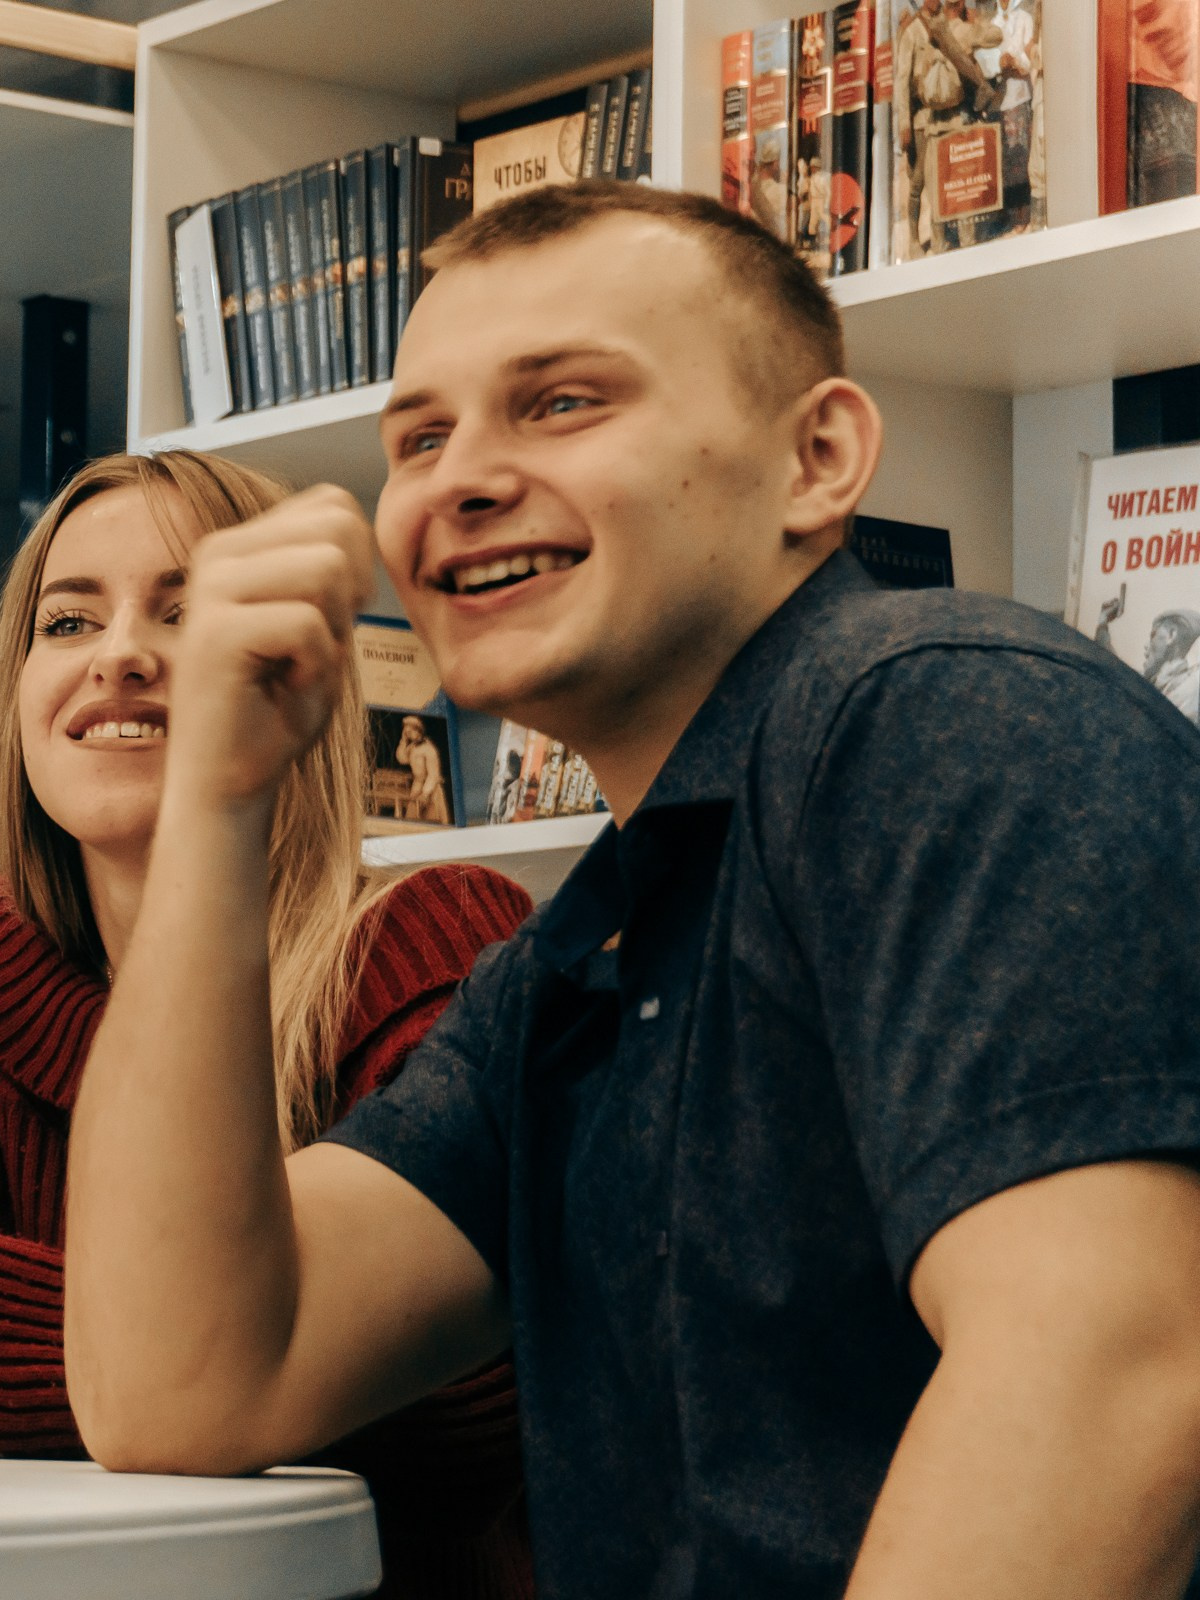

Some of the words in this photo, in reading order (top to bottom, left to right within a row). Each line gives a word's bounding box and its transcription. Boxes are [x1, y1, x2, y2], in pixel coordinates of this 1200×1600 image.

[494, 155, 547, 190] ЧТОБЫ
[1107, 484, 1199, 520] ЧИТАЕМ
[1101, 539, 1117, 575] О
